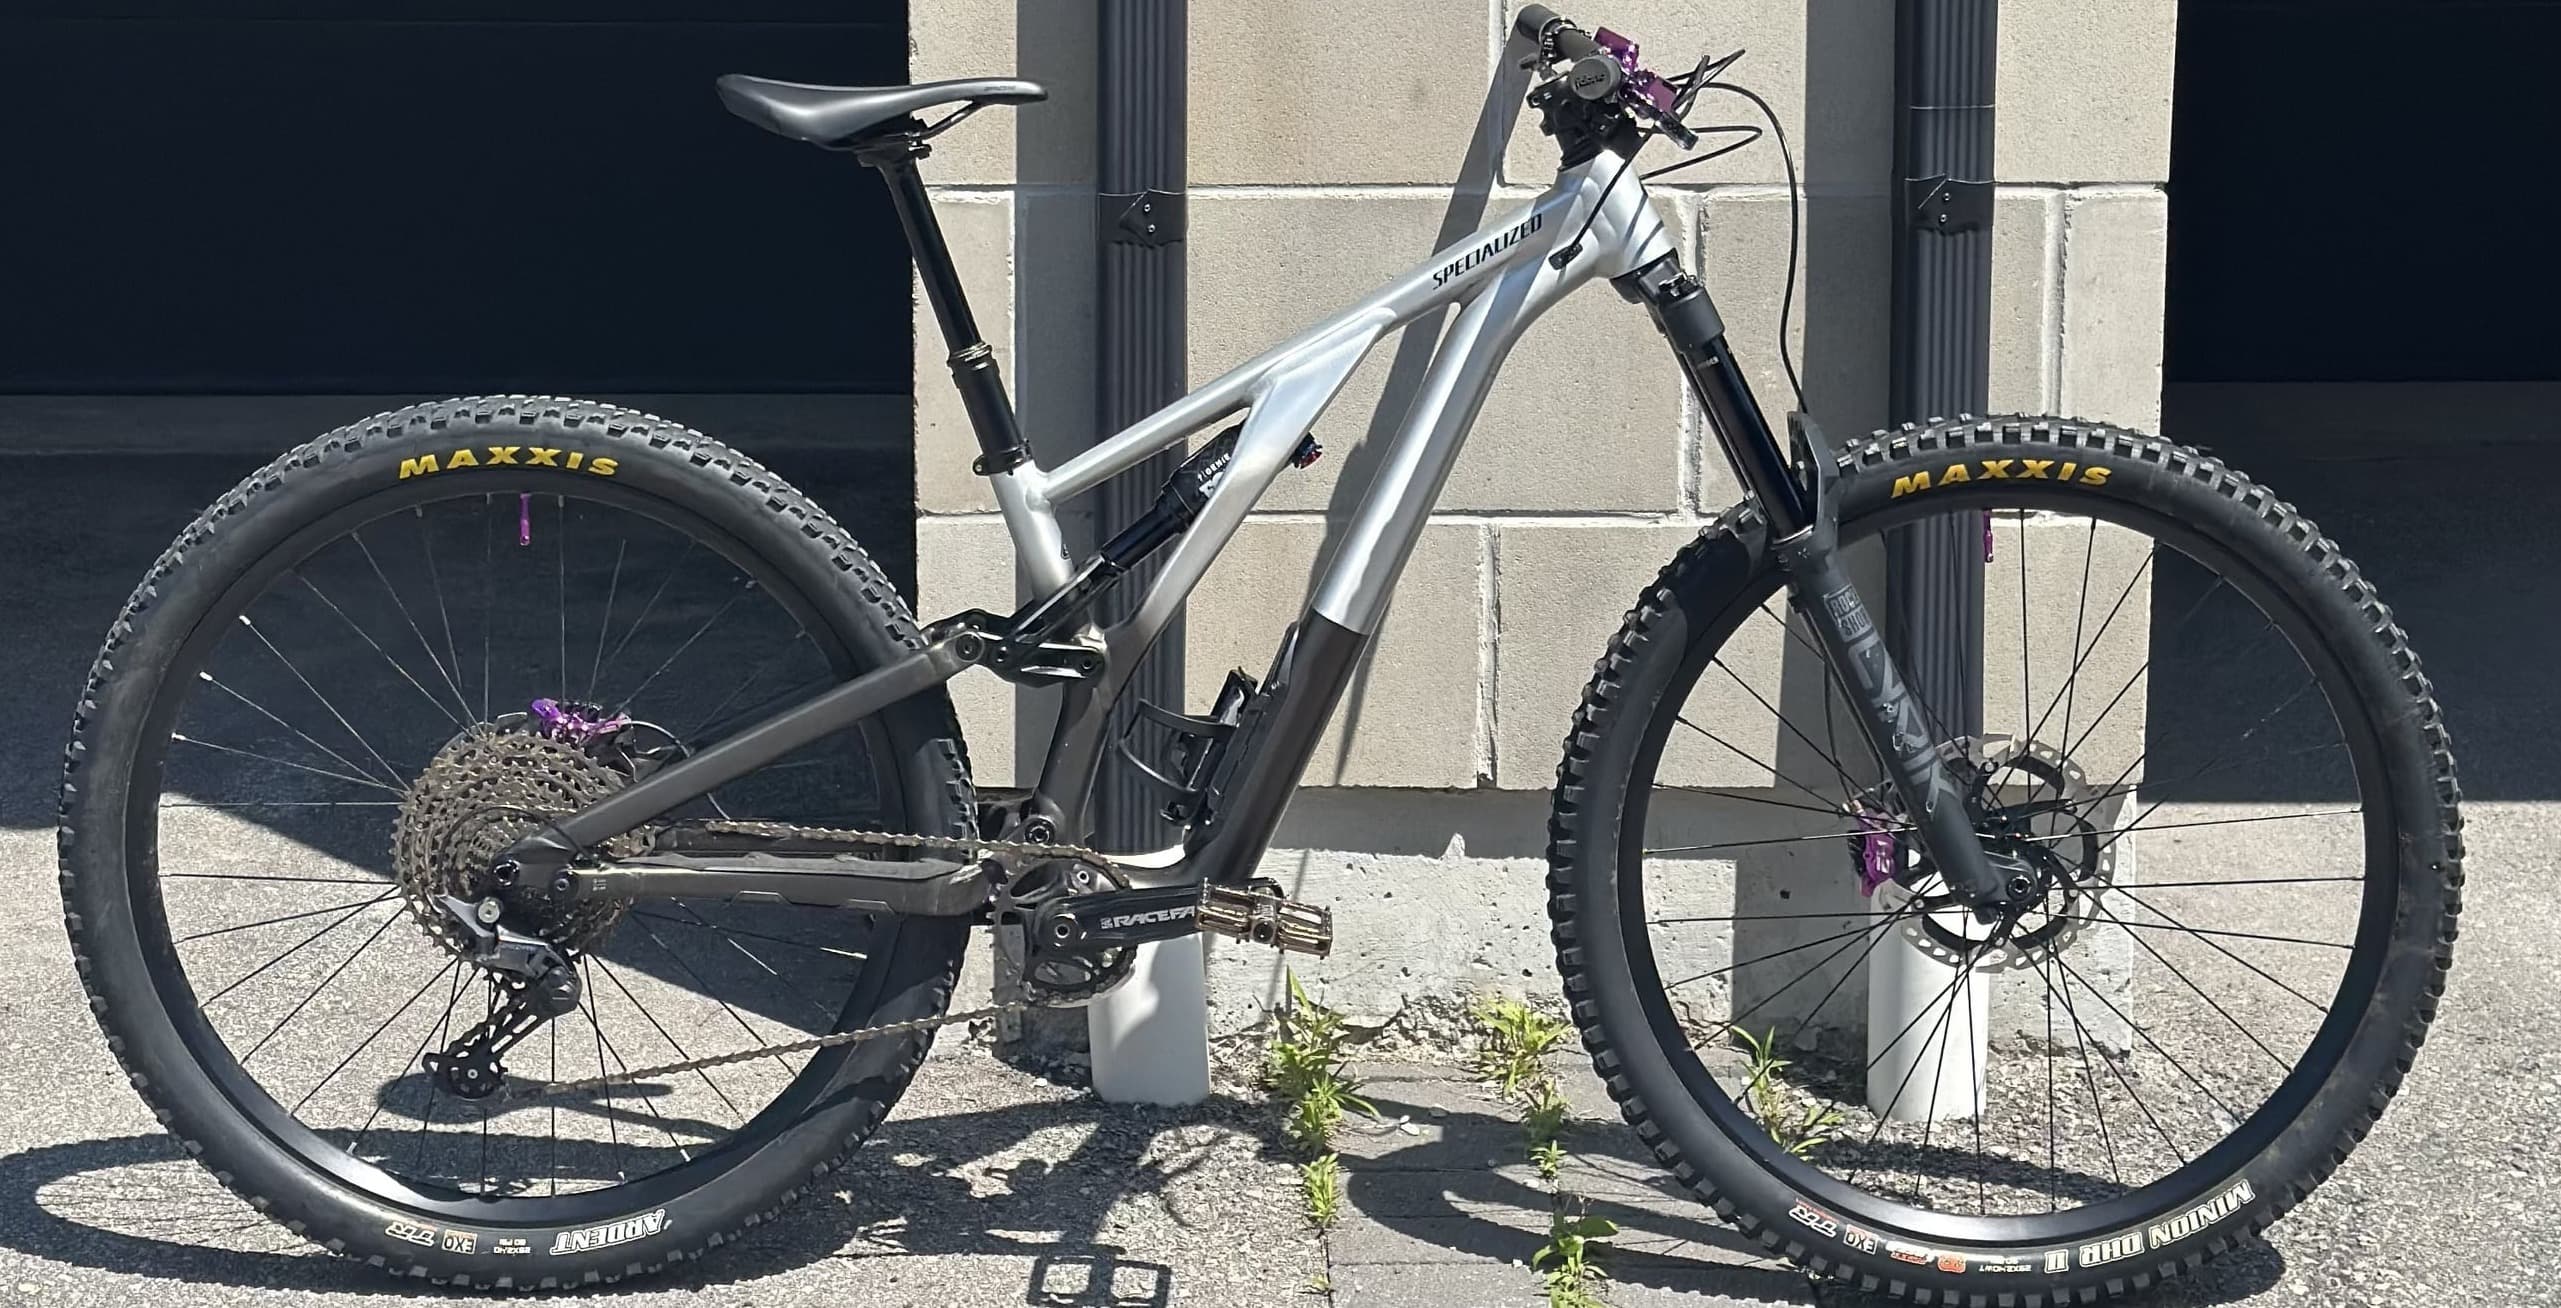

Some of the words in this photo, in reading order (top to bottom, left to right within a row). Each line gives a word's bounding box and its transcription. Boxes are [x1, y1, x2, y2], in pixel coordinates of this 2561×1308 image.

[1432, 213, 1543, 290] SPECIALIZED
[399, 446, 619, 479] MAXXIS
[1890, 459, 2112, 499] MAXXIS
[1111, 905, 1196, 929] RACEFA
[550, 1209, 665, 1255] ARDENT
[2149, 1179, 2255, 1249] MINION
[443, 1236, 474, 1254] EXO
[2079, 1232, 2145, 1267] DHR
